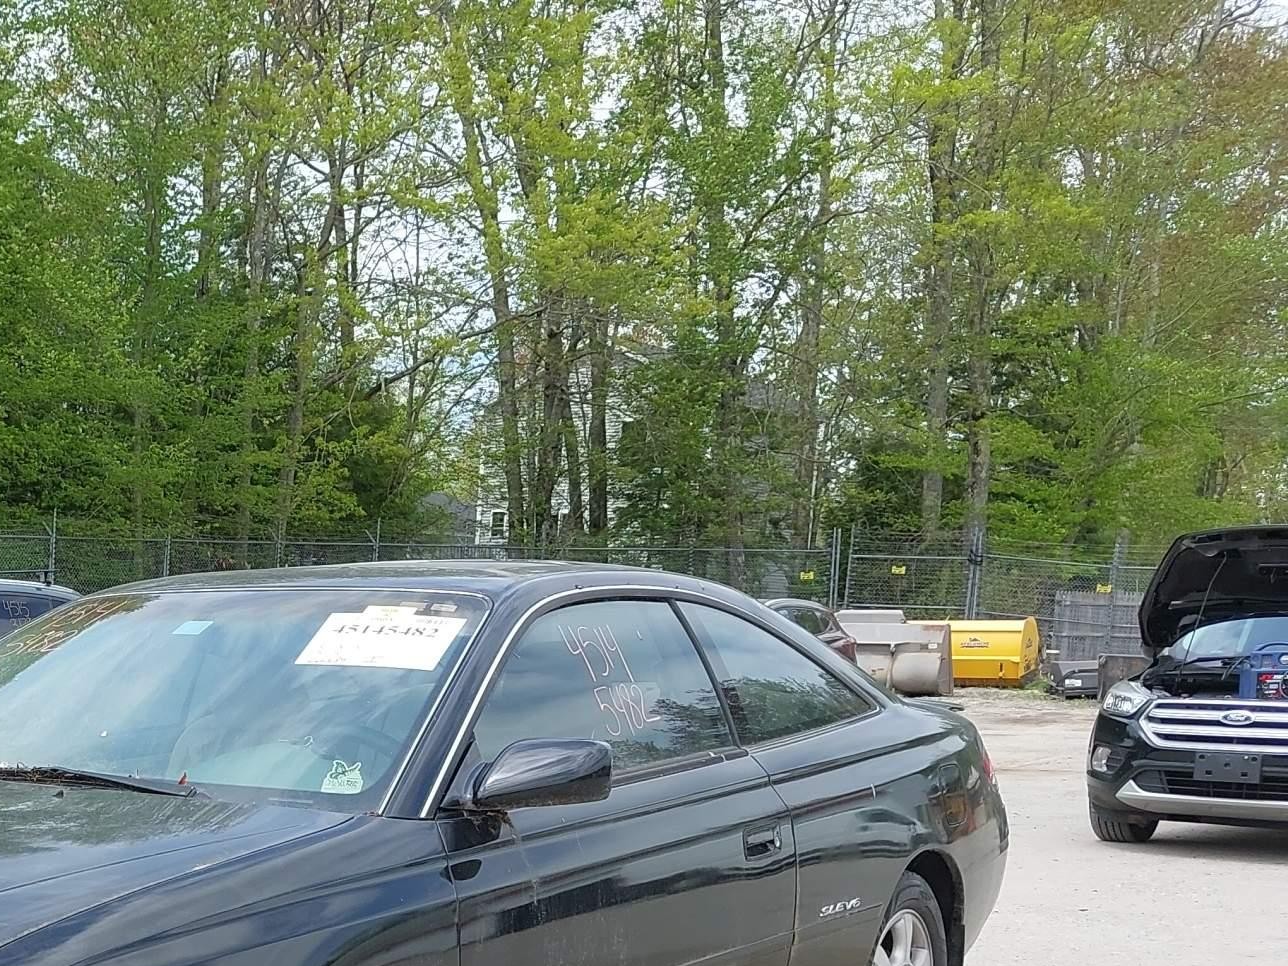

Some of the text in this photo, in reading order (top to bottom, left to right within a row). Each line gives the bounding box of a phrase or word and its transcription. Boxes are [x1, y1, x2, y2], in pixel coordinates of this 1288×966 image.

[333, 623, 440, 639] 45145482
[557, 624, 635, 683] 4514
[593, 684, 662, 737] 5482
